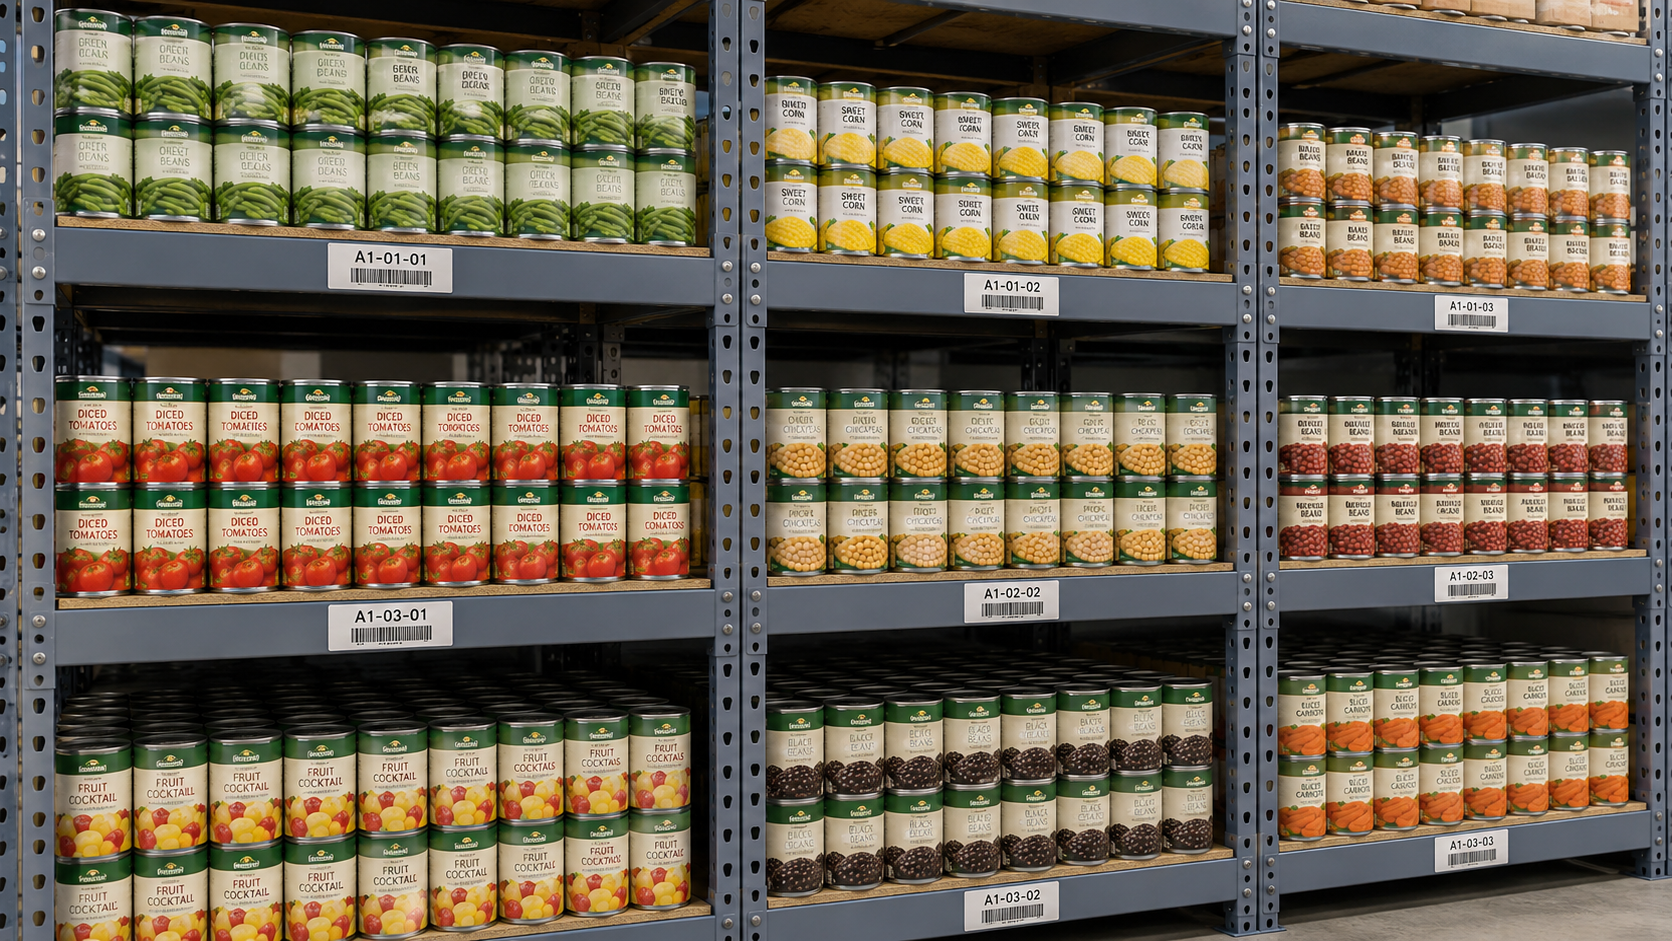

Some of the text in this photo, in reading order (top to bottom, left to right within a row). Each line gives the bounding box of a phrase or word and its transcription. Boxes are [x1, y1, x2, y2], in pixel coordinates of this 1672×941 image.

[393, 74, 420, 84] BEANS
[160, 156, 190, 166] BEANS
[781, 189, 806, 198] SWEET
[782, 198, 806, 206] CORN
[842, 201, 865, 210] CORN
[355, 250, 426, 265] A1-01-01
[985, 280, 1040, 292] A1-01-02
[1450, 301, 1493, 312] A1-01-03
[78, 409, 107, 419] DICED
[156, 410, 184, 420] DICED
[231, 410, 258, 420] DICED
[304, 410, 332, 420] DICED
[377, 412, 402, 421] DICED
[447, 412, 472, 422] DICED
[517, 413, 541, 422] DICED
[586, 414, 610, 423] DICED
[653, 414, 676, 423] DICED
[69, 420, 117, 431] TOMATOES
[509, 424, 549, 433] TOMATOES
[377, 514, 403, 524] DICED
[447, 514, 472, 523] DICED
[517, 513, 542, 523] DICED
[586, 512, 610, 521] DICED
[653, 511, 676, 520] DICED
[78, 518, 108, 528] DICED
[155, 517, 184, 528] DICED
[231, 516, 258, 527] DICED
[305, 516, 332, 526] DICED
[69, 529, 118, 540] TOMATOES
[222, 528, 268, 537] TOMATOES
[295, 526, 340, 536] TOMATOES
[1450, 570, 1493, 581] A1-02-03
[984, 587, 1040, 599] A1-02-02
[355, 609, 426, 623] A1-03-01
[590, 747, 614, 758] FRUIT
[654, 742, 678, 753] FRUIT
[454, 756, 479, 767] FRUIT
[523, 752, 548, 762] FRUIT
[307, 766, 334, 777] FRUIT
[382, 761, 409, 773] FRUIT
[233, 771, 261, 782] FRUIT
[373, 771, 417, 783] COCKTAIL
[156, 777, 184, 787] FRUIT
[224, 781, 269, 793] COCKTAIL
[298, 776, 343, 788] COCKTAIL
[78, 782, 108, 793] FRUIT
[68, 792, 117, 804] COCKTAIL
[1450, 836, 1493, 850] A1-03-03
[523, 852, 548, 862] FRUIT
[454, 858, 480, 869] FRUIT
[382, 864, 409, 875] FRUIT
[308, 871, 335, 882] FRUIT
[233, 878, 261, 888] FRUIT
[299, 882, 344, 894] COCKTAIL
[156, 885, 184, 895] FRUIT
[224, 888, 269, 899] COCKTAIL
[78, 892, 108, 903] FRUIT
[984, 890, 1040, 905] A1-03-02
